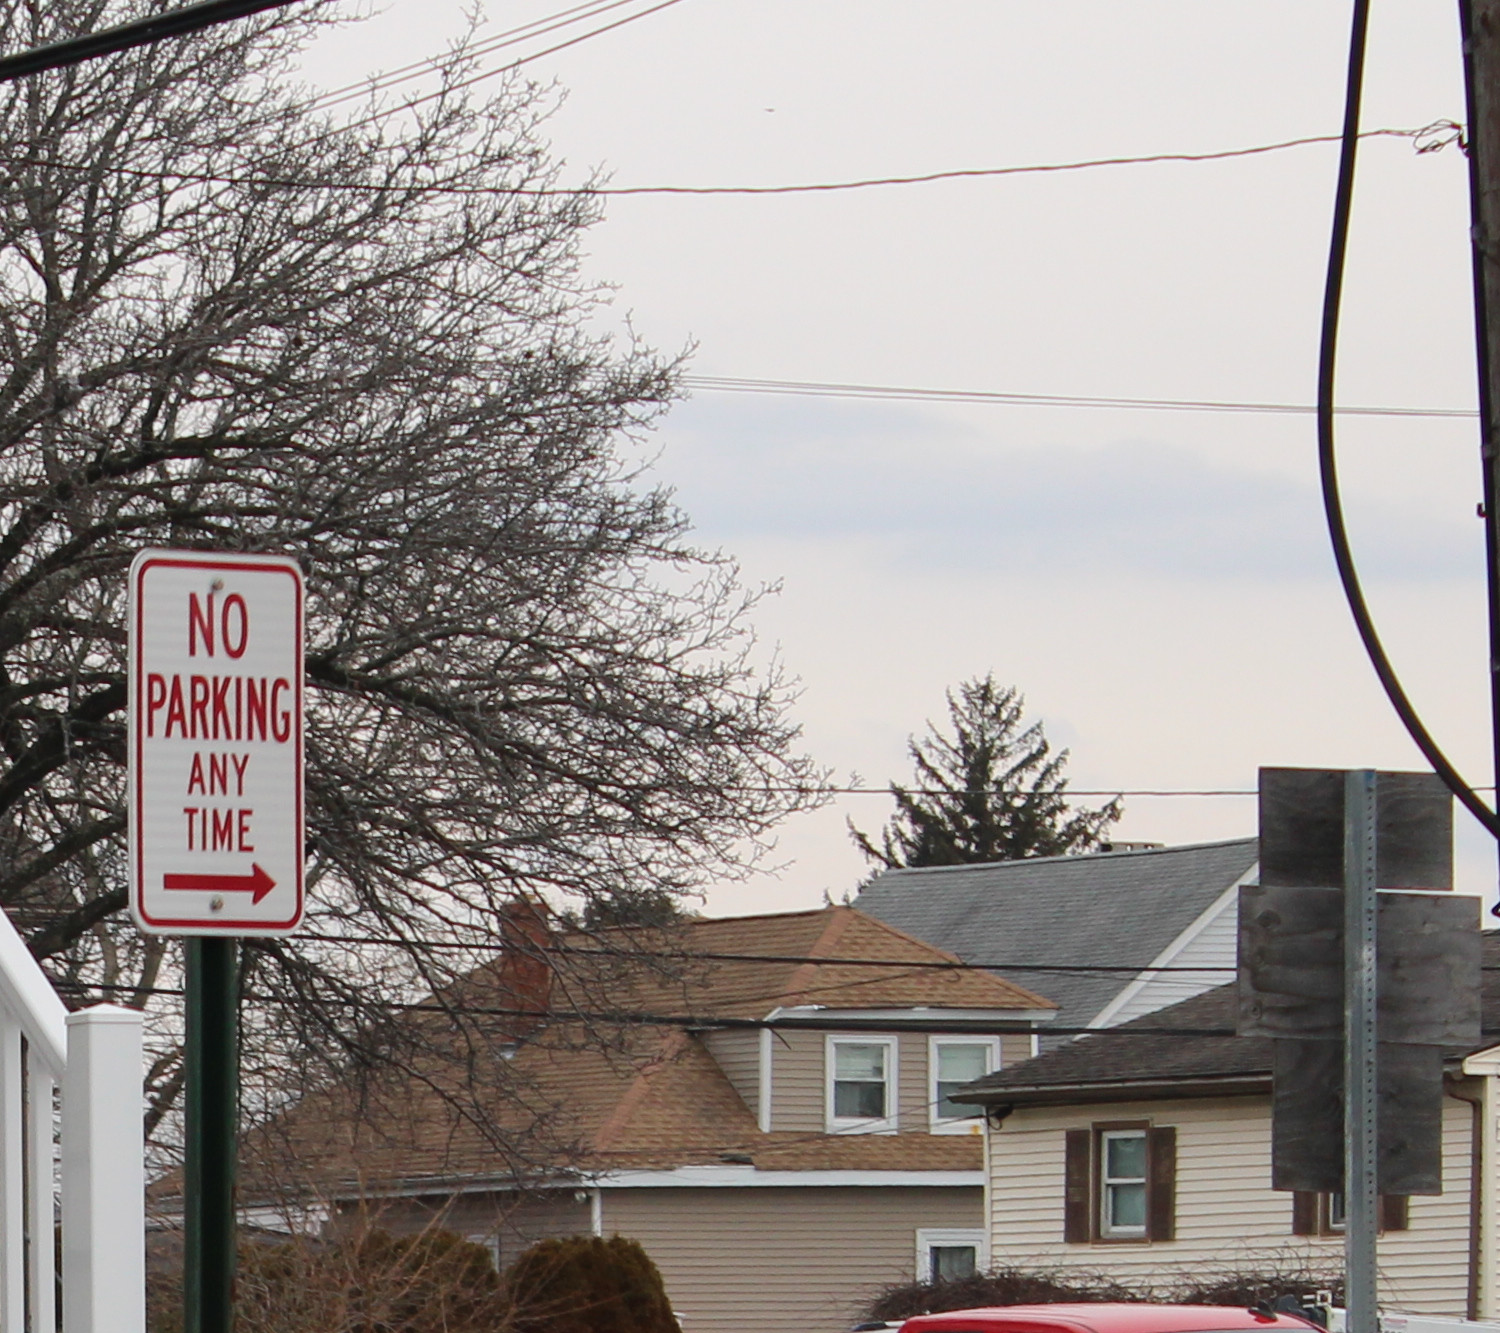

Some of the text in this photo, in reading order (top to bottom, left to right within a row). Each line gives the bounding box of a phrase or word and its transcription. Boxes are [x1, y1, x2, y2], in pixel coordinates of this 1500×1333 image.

[188, 592, 249, 660] NO
[146, 673, 291, 743] PARKING
[187, 753, 250, 797] ANY
[183, 807, 255, 853] TIME
